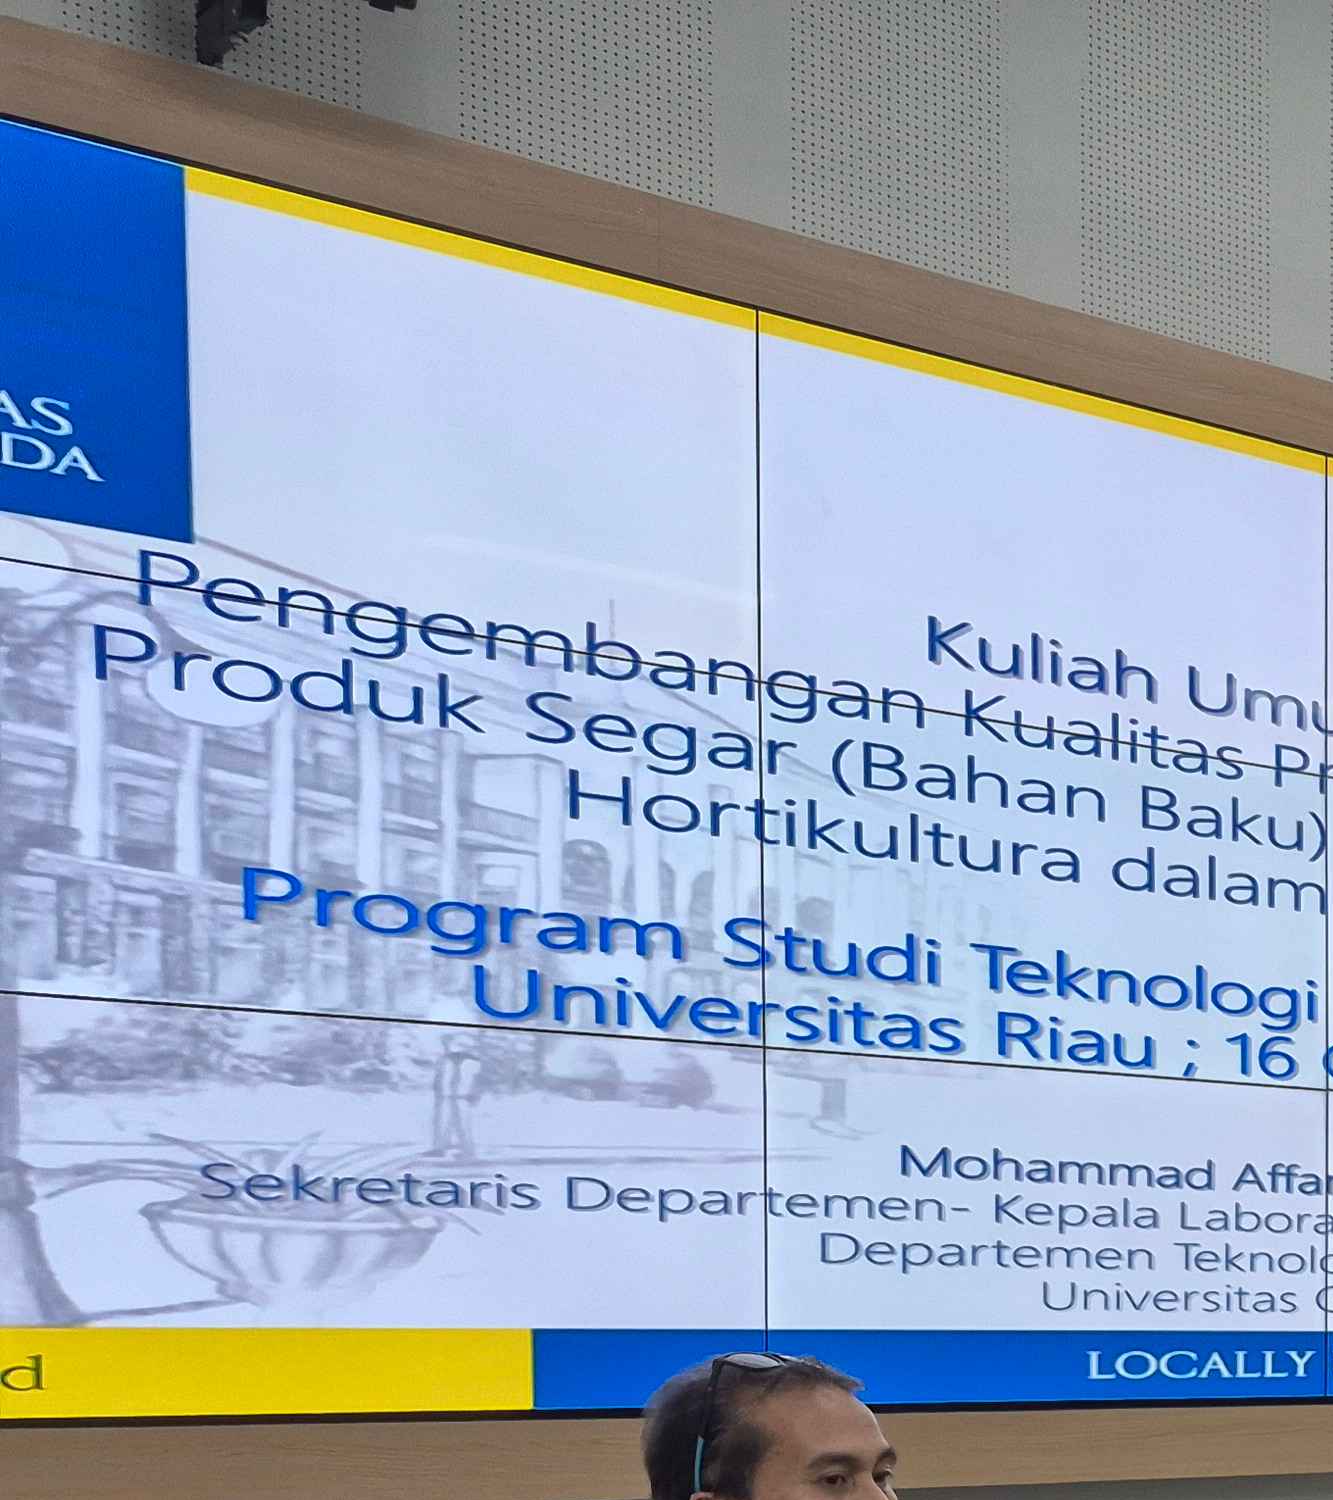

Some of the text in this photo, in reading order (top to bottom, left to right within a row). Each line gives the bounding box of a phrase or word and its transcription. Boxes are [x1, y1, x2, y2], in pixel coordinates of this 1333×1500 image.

[137, 549, 926, 730] Pengembangan
[965, 689, 1243, 780] Kualitas
[927, 615, 1157, 704] Kuliah
[92, 623, 485, 734] Produk
[525, 690, 797, 775] Segar
[830, 737, 1105, 822] (Bahan
[1140, 784, 1326, 862] Baku)
[568, 768, 1081, 884] Hortikultura
[1112, 846, 1326, 915] dalam
[240, 865, 684, 961] Program
[722, 916, 943, 988] Studi
[970, 941, 1320, 1032] Teknologi
[472, 964, 965, 1055] Universitas
[997, 1010, 1156, 1070] Riau
[1226, 1031, 1300, 1083] 16
[200, 1162, 541, 1211] Sekretaris
[566, 1175, 970, 1222] Departemen-
[995, 1193, 1160, 1234] Kepala
[900, 1144, 1215, 1193] Mohammad
[820, 1231, 1154, 1273] Departemen
[1042, 1281, 1299, 1313] Universitas
[1087, 1350, 1315, 1380] LOCALLY
